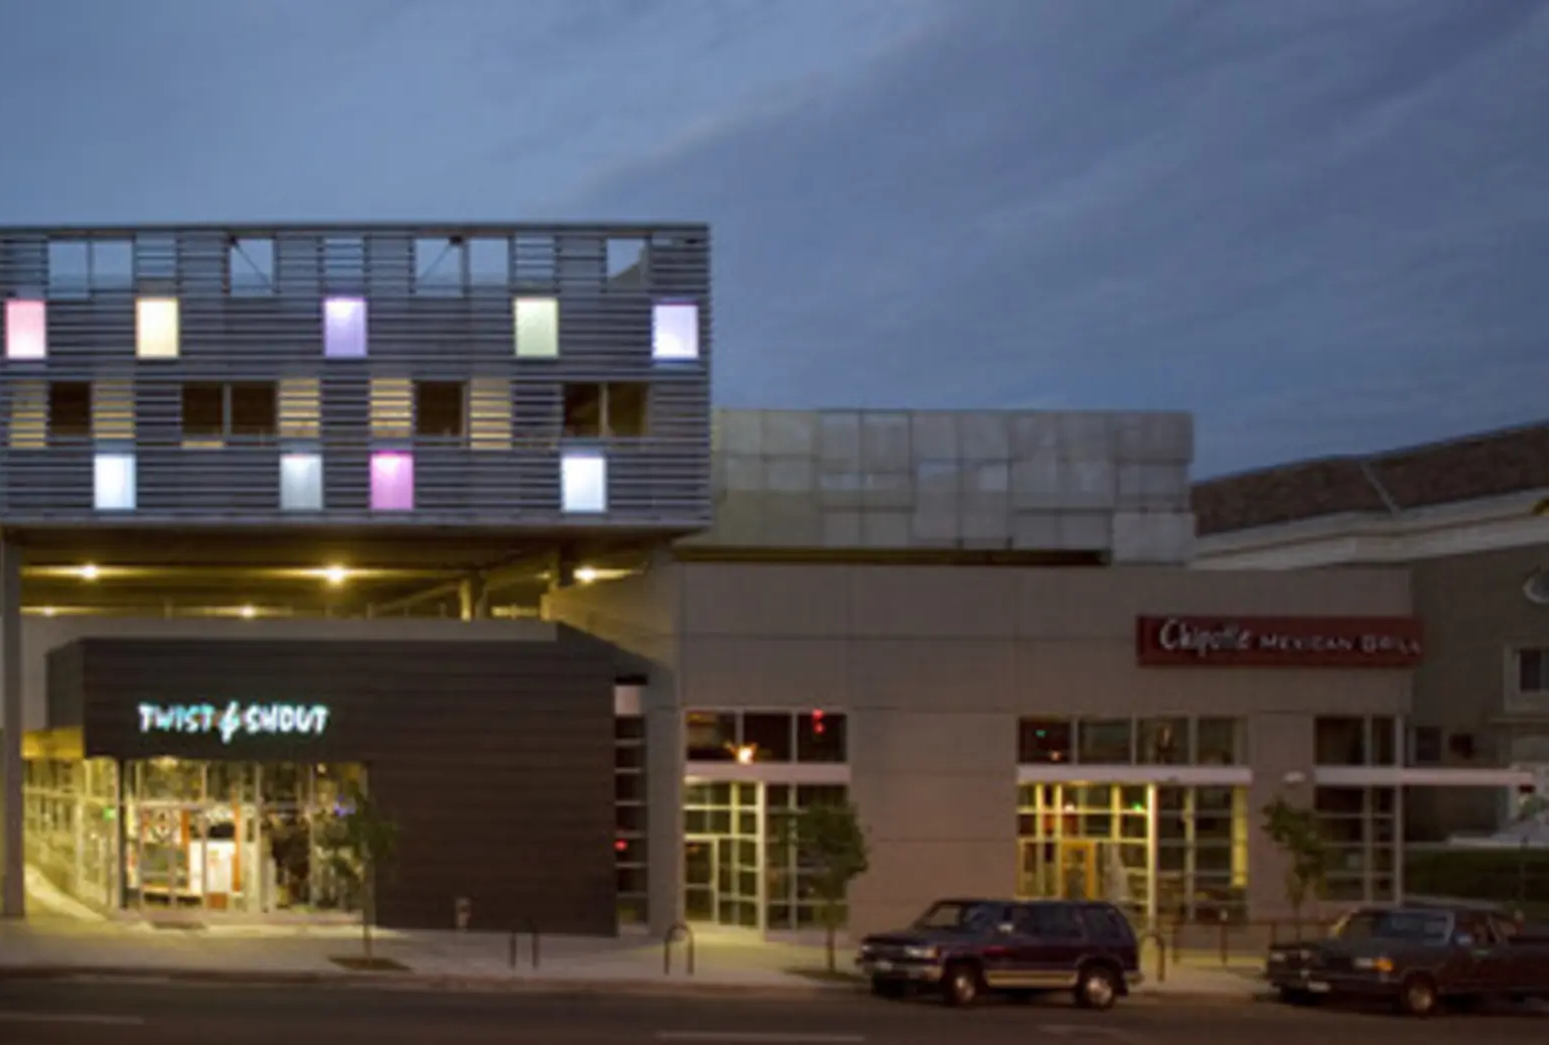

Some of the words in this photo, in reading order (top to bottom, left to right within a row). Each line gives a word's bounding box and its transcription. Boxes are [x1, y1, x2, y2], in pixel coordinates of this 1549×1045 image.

[1158, 616, 1252, 657] Chipotle
[1259, 633, 1353, 652] MEXICAN
[139, 702, 215, 733] TWIST
[245, 704, 327, 734] SHOUT
